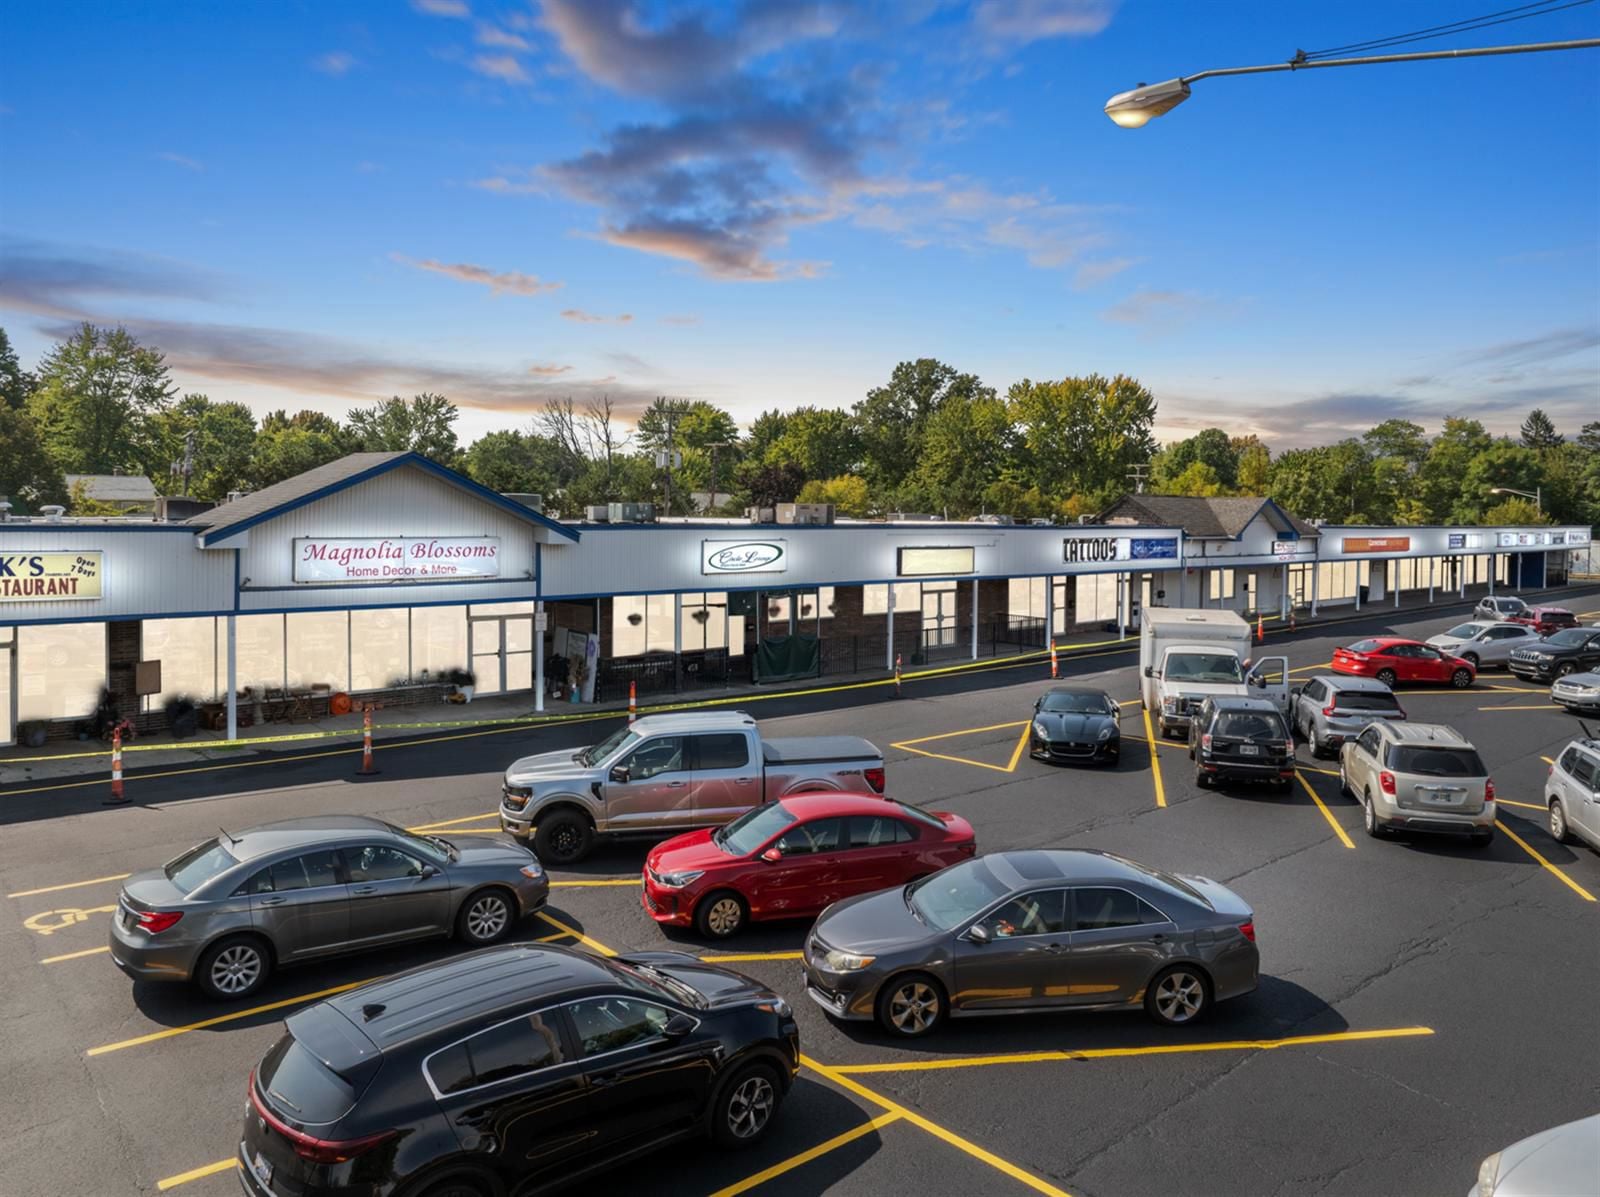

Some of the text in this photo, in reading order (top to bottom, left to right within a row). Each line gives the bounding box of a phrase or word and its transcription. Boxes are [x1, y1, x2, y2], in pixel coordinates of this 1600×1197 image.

[303, 540, 497, 566] Magnolia Blossoms
[1063, 538, 1118, 562] TATTOOS
[0, 556, 44, 577] K'S
[76, 556, 95, 567] Open
[77, 566, 95, 577] Days
[347, 565, 457, 577] Home Decor & More
[0, 578, 78, 596] TAURANT
